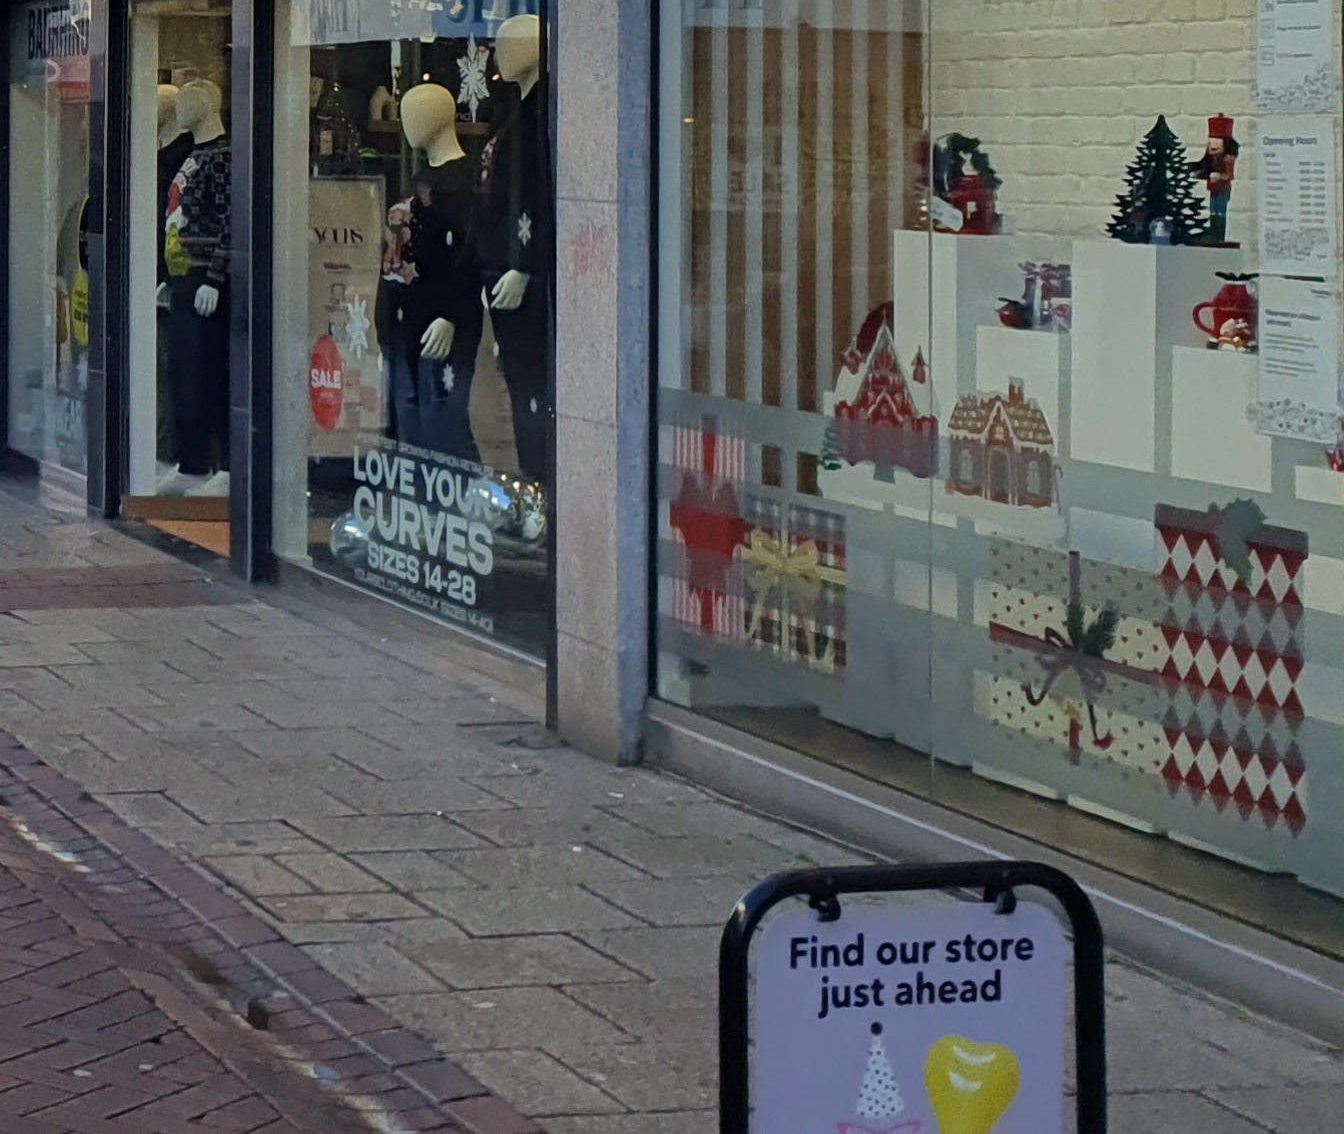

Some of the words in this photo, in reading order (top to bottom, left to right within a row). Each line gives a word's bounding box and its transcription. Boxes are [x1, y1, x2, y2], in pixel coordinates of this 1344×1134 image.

[311, 369, 342, 390] SALE
[353, 445, 416, 496] LOVE
[421, 463, 494, 521] YOUR
[353, 485, 494, 575] CURVES
[367, 541, 420, 584] SIZES
[423, 560, 476, 605] 14-28
[789, 933, 865, 969] Find
[876, 940, 936, 966] our
[945, 933, 1035, 965] store
[818, 975, 885, 1019] just
[895, 969, 1002, 1005] ahead
